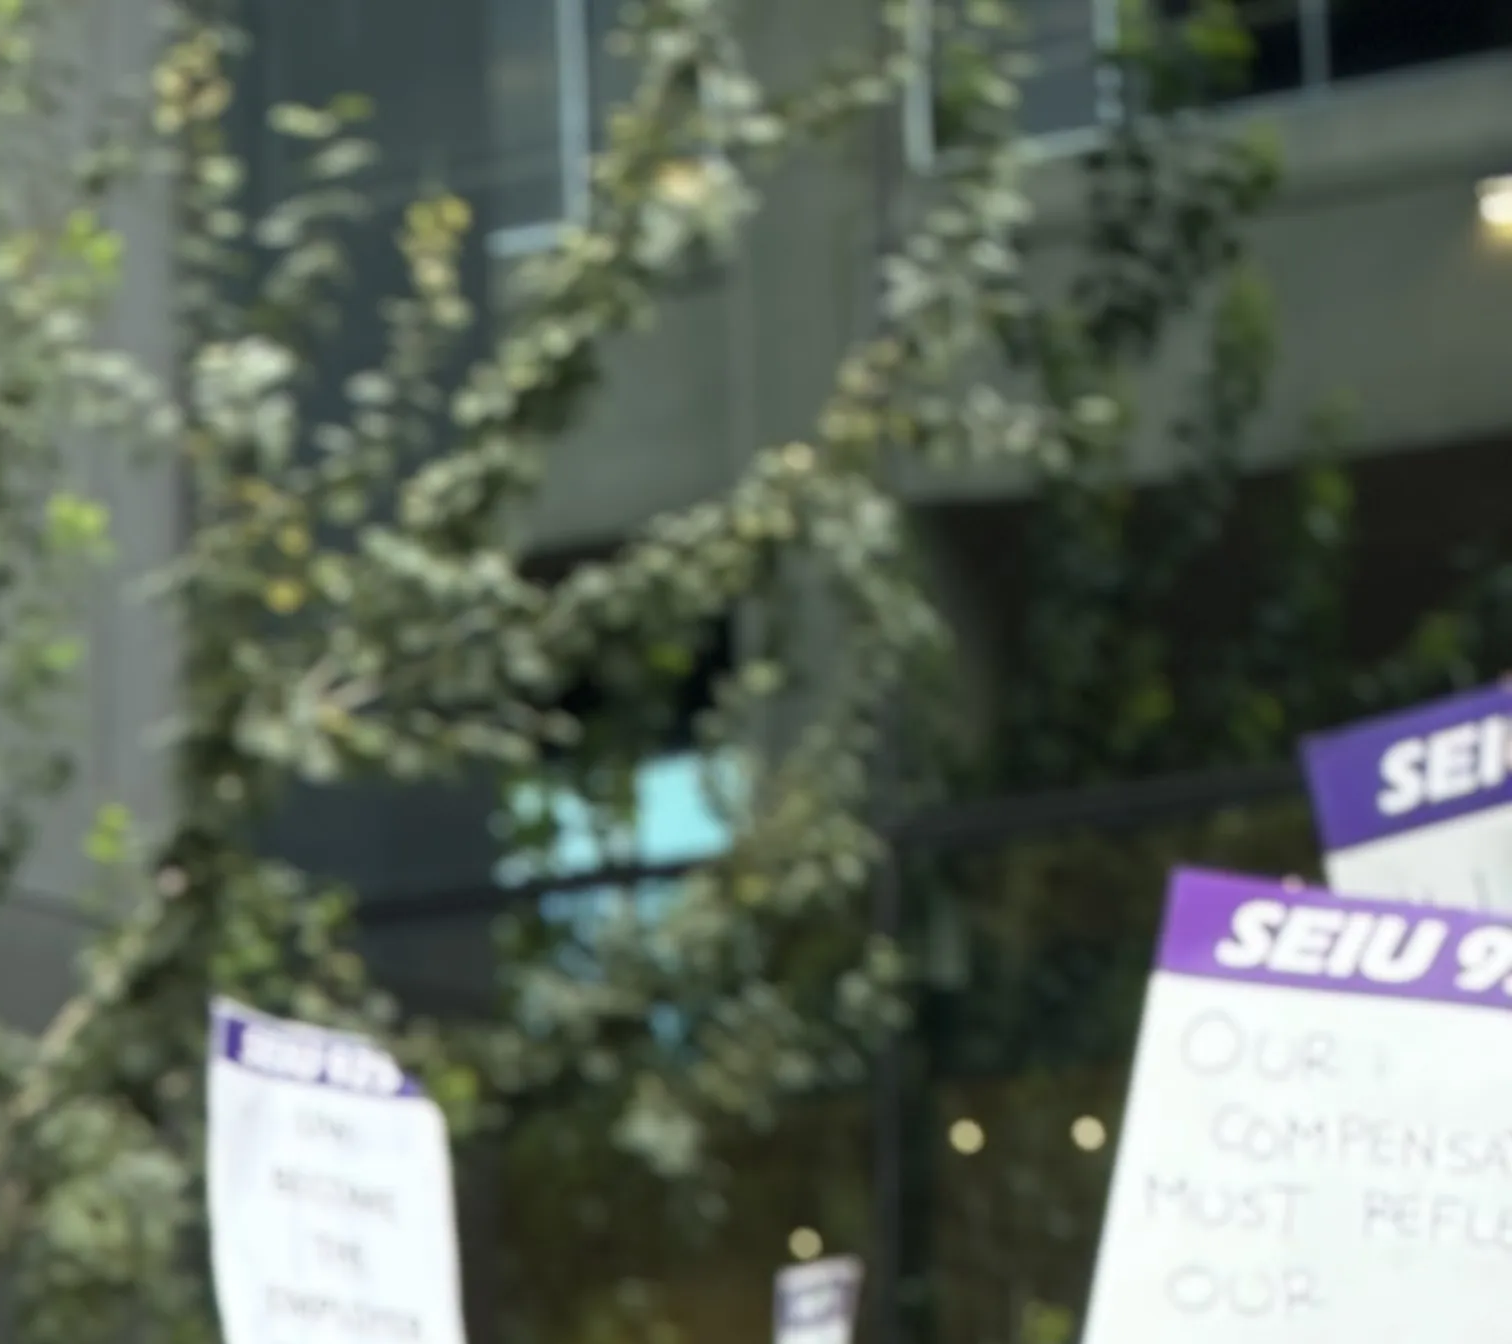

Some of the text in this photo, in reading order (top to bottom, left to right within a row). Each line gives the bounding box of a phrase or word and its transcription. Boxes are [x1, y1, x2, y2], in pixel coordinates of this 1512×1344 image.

[1375, 713, 1512, 815] SEI
[1213, 897, 1512, 996] SEIU 9
[1180, 1005, 1342, 1084] OUR
[1210, 1100, 1512, 1180] COMPENSA
[1143, 1168, 1314, 1234] MUST
[1162, 1258, 1331, 1320] OUR
